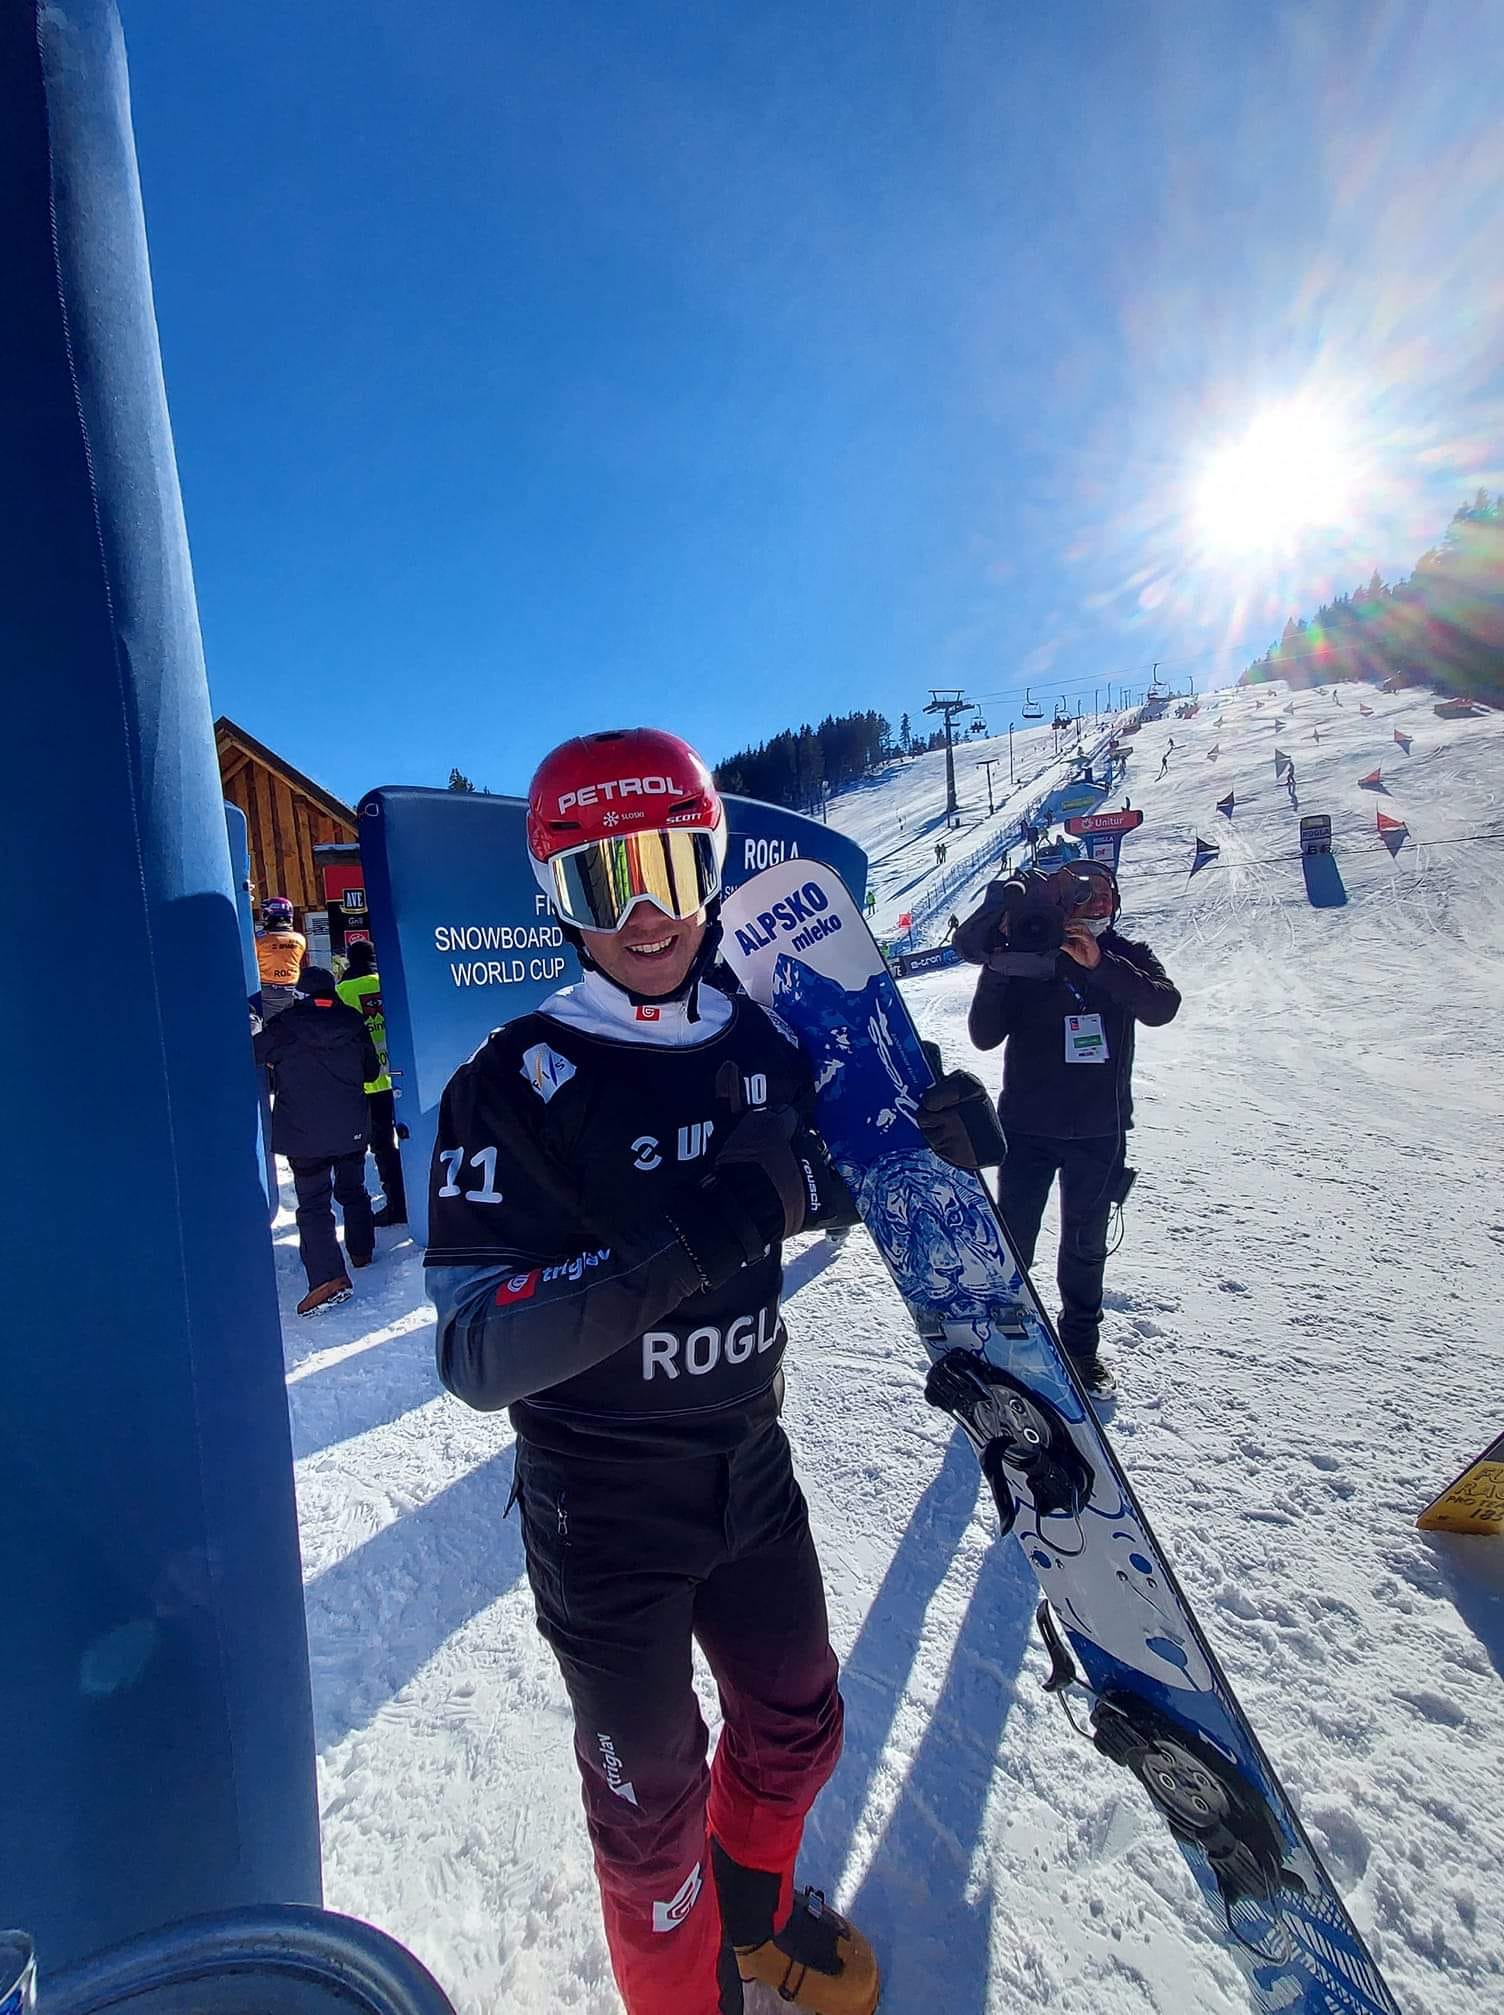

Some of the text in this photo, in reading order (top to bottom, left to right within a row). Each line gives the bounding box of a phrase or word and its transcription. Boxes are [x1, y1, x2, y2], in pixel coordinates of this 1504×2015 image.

[558, 776, 683, 815] PETROL
[665, 812, 703, 825] SCOTT
[1095, 816, 1123, 827] Unitur
[744, 838, 799, 870] ROGLA
[535, 894, 556, 916] FI
[734, 882, 828, 957] ALPSKO
[435, 926, 563, 951] SNOWBOARD
[791, 914, 842, 953] mleko
[450, 957, 565, 987] WORLD CUP
[597, 1732, 623, 1786] triglav
